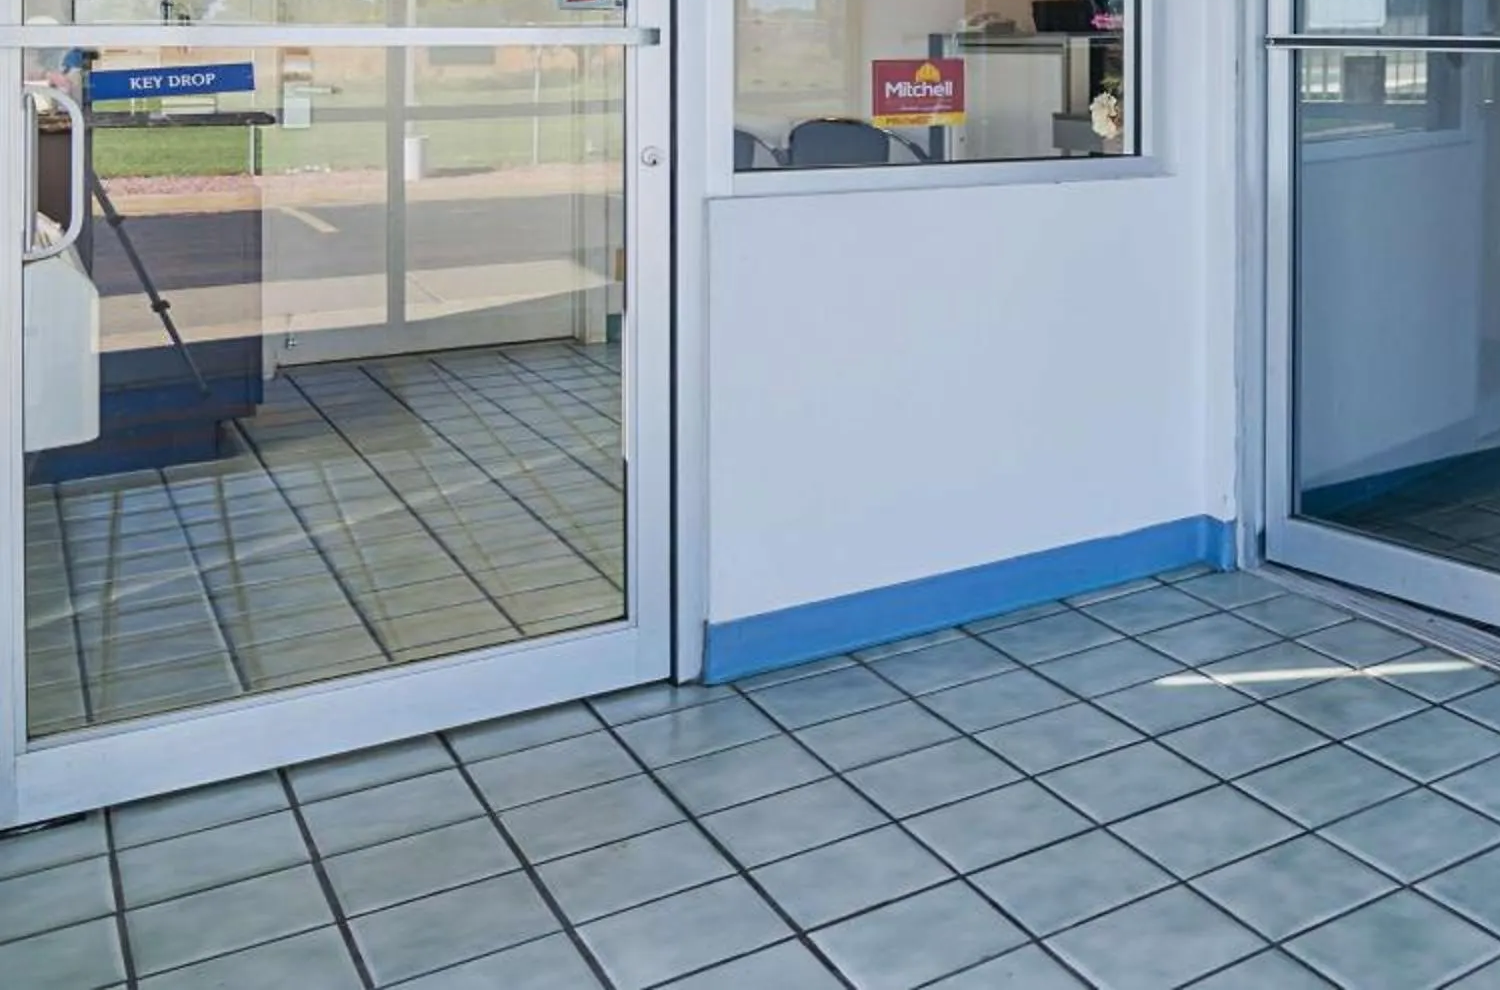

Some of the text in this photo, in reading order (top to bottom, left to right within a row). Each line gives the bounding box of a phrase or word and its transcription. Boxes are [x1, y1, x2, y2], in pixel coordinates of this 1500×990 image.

[129, 73, 216, 90] KEY DROP
[884, 81, 954, 99] Mitchell
